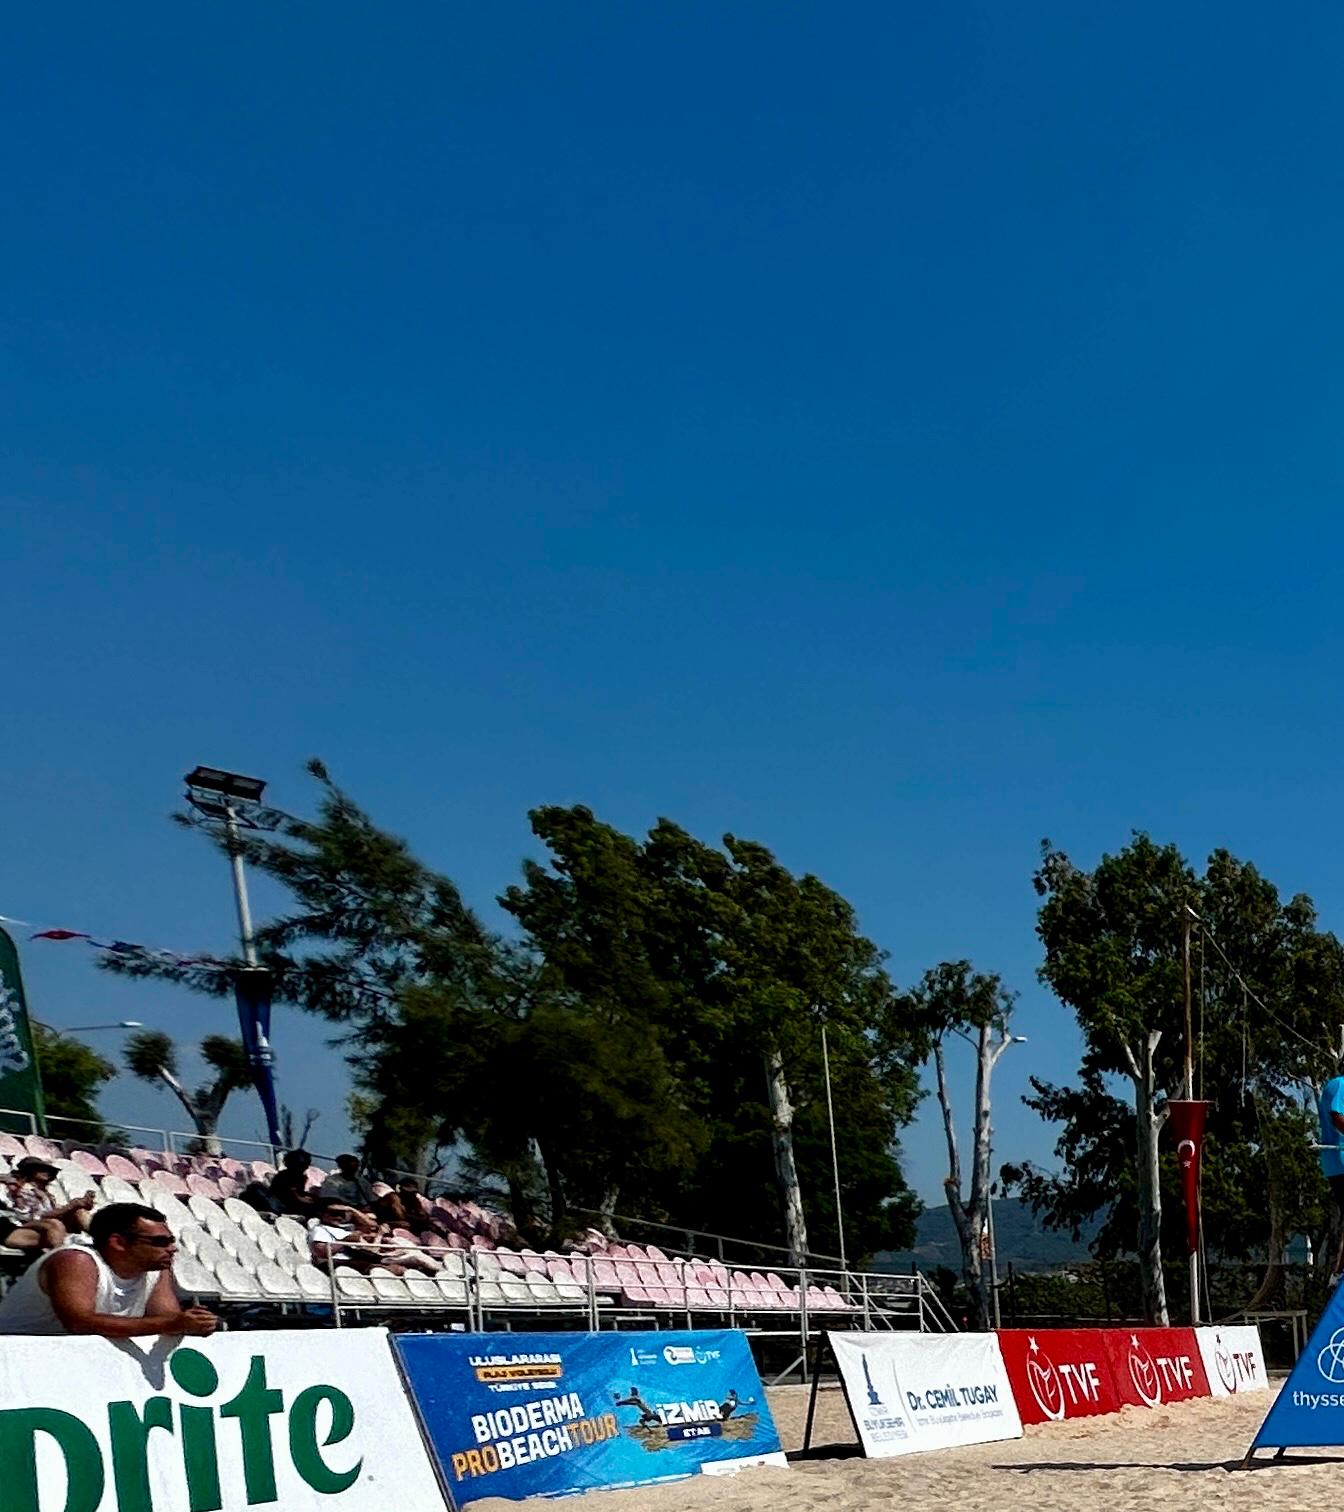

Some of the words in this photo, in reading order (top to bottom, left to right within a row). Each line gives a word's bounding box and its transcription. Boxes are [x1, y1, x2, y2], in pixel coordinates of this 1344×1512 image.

[1059, 1362, 1101, 1404] TVF
[1156, 1357, 1193, 1391] TVF
[1234, 1352, 1256, 1382] TVF
[906, 1391, 926, 1411] Dr.
[925, 1384, 961, 1410] CEMİL
[959, 1385, 998, 1406] TUGAY
[472, 1393, 585, 1443] BIODERMA
